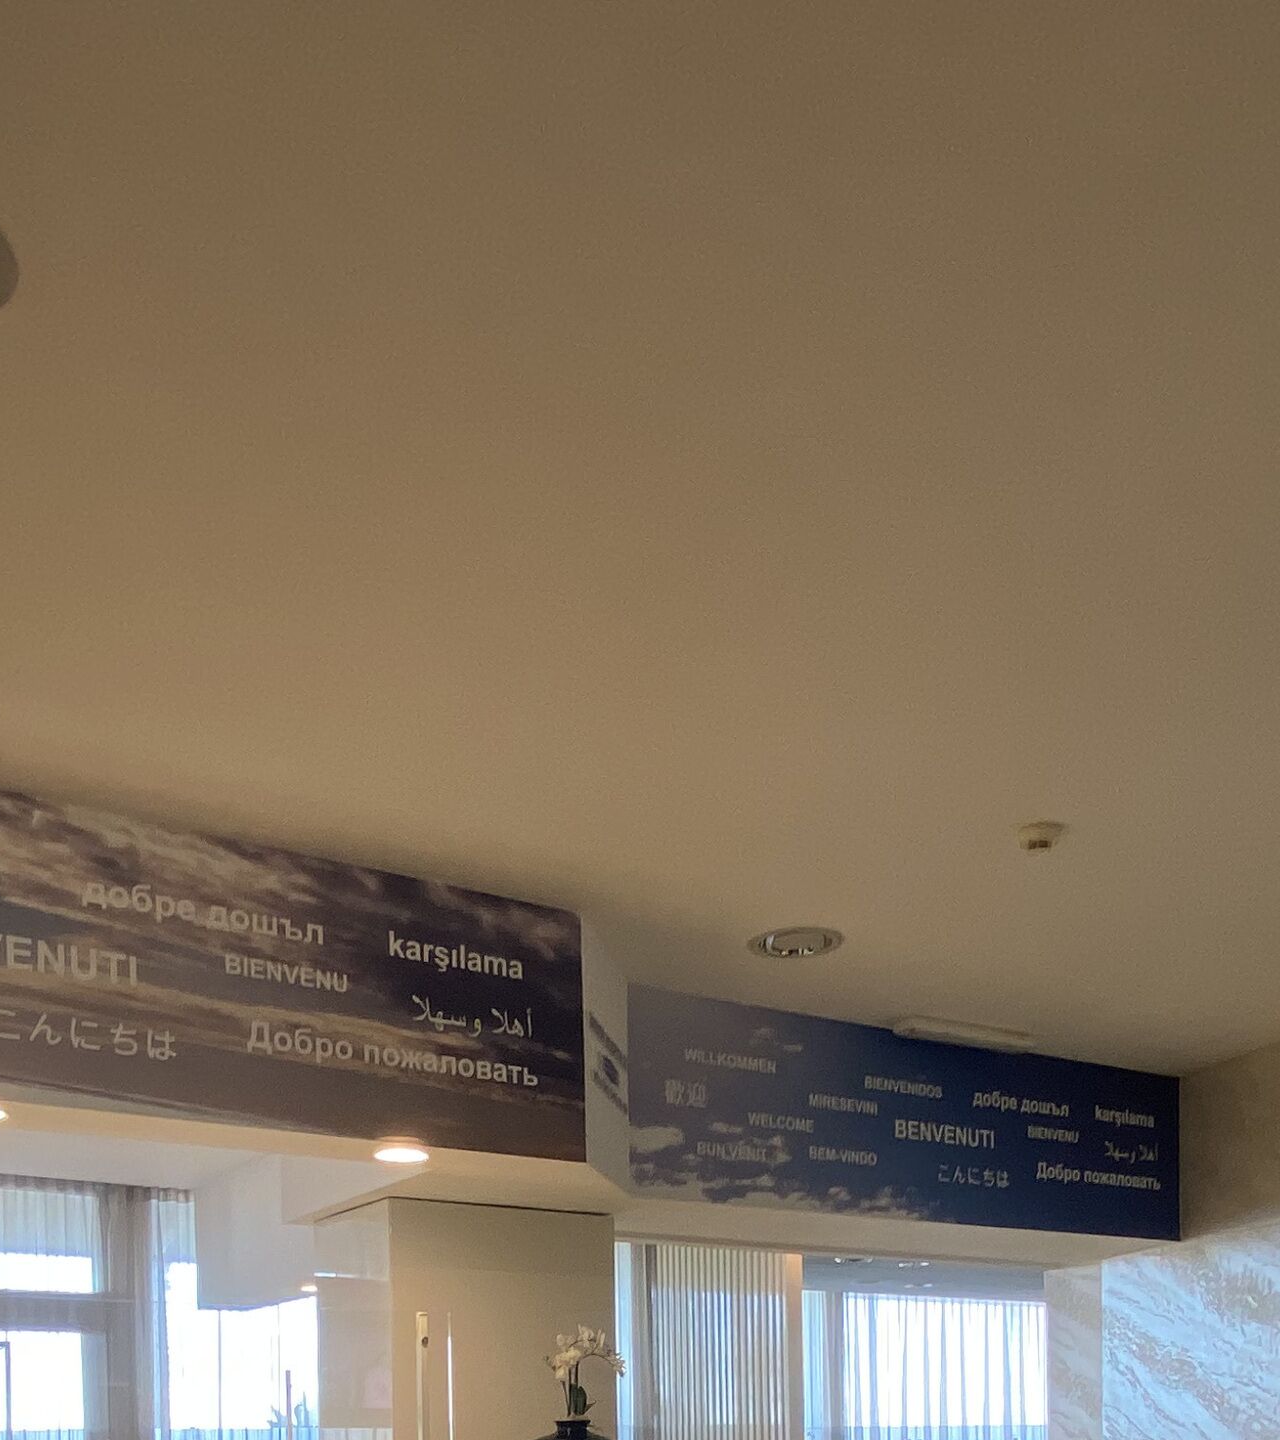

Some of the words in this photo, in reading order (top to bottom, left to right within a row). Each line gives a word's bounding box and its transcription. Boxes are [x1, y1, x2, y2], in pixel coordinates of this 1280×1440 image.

[81, 882, 196, 924] добре
[206, 904, 324, 945] дошъл
[388, 930, 524, 980] karşılama
[225, 953, 348, 993] BIENVENU
[247, 1019, 353, 1063] Добро
[363, 1043, 539, 1088] пожаловать
[684, 1048, 776, 1074] WILLKOMMEN
[864, 1075, 943, 1098] BIENVENIDOS
[809, 1093, 878, 1117] MIRESEVINI
[973, 1091, 1018, 1112] добре
[748, 1112, 815, 1134] WELCOME
[1095, 1105, 1155, 1128] karşılama
[894, 1119, 995, 1149] BENVENUTI
[809, 1146, 878, 1167] BEM-VINDO
[937, 1164, 1010, 1189] こんにちは
[1036, 1161, 1080, 1184] Добро
[1084, 1169, 1161, 1191] пожаловать
